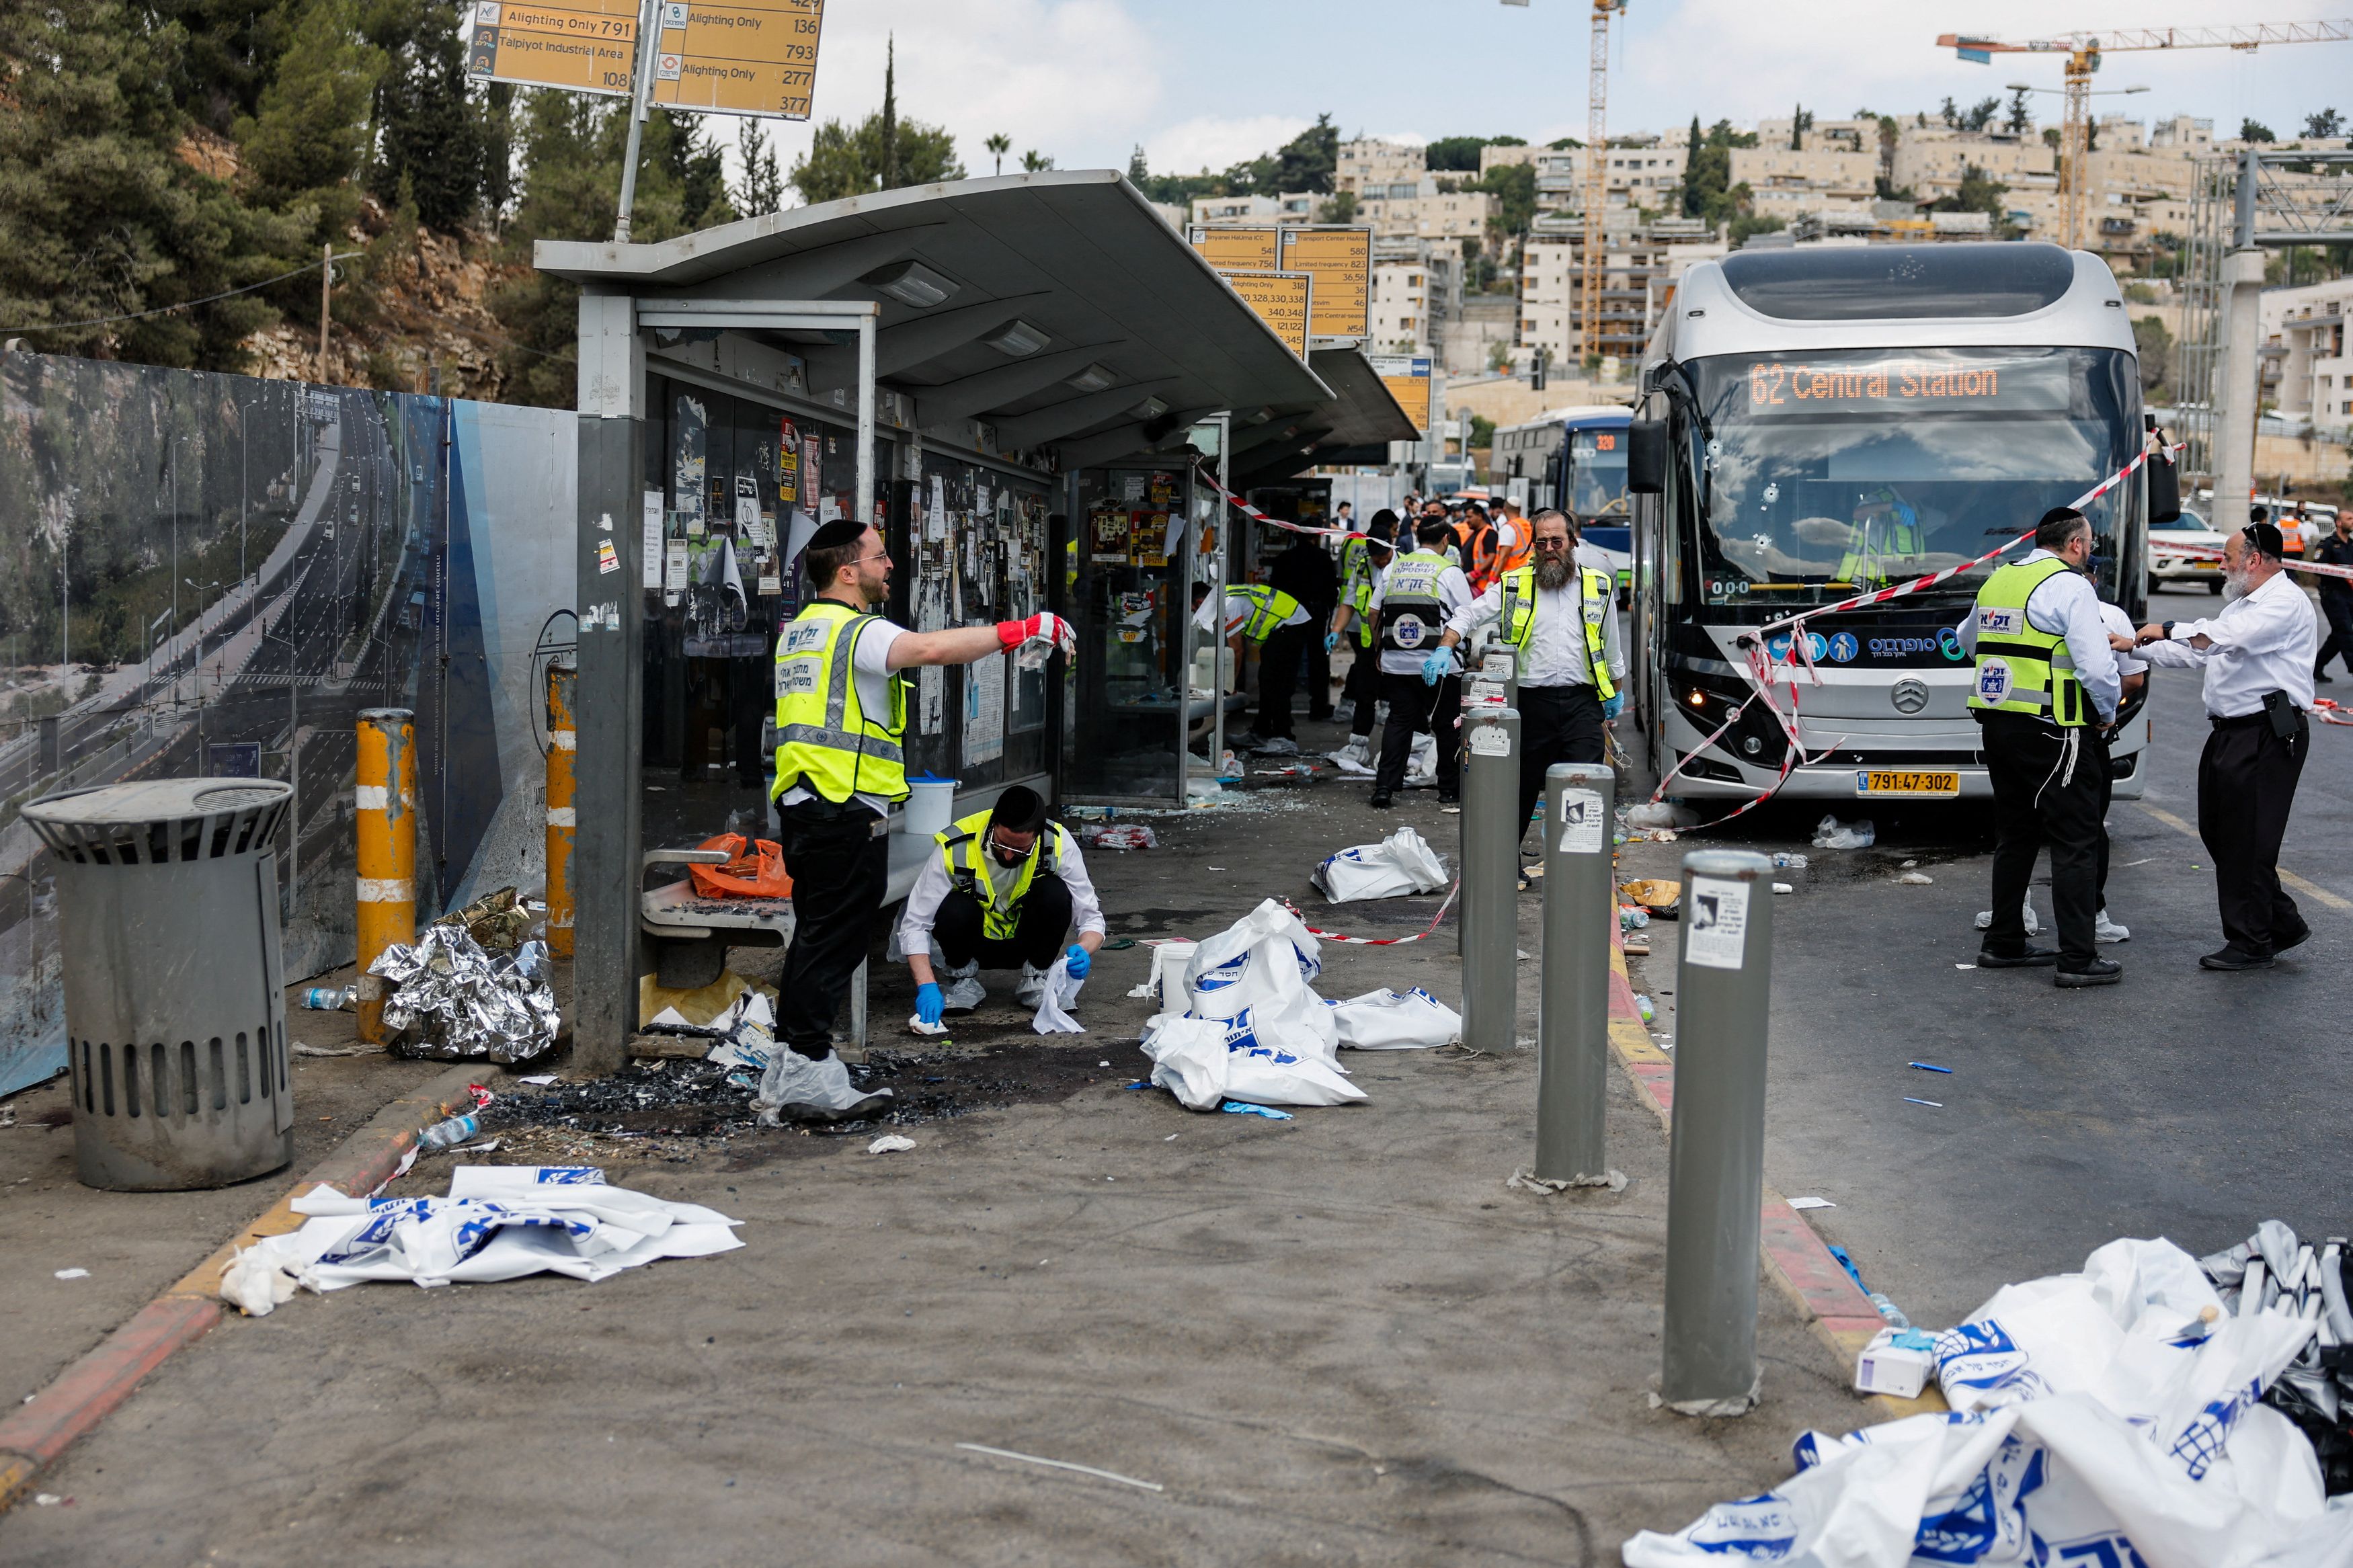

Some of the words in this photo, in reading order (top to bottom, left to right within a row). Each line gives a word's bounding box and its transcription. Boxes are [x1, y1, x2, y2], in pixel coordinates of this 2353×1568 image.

[508, 11, 564, 29] Alighting
[569, 19, 598, 33] Only
[600, 21, 630, 37] 791
[688, 13, 735, 28] Alighting
[737, 17, 762, 30] Only
[795, 19, 817, 34] 136
[500, 36, 543, 51] Talpiyot
[546, 42, 594, 56] Industrial
[598, 46, 623, 59] Area
[786, 44, 813, 60] 793
[603, 72, 627, 87] 108
[682, 65, 727, 79] Alighting
[731, 68, 756, 81] Only
[783, 71, 811, 86] 277
[780, 97, 808, 112] 377
[1227, 259, 1257, 267] frequency
[1343, 274, 1365, 282] 36,56
[1232, 282, 1258, 290] Alighting
[1259, 282, 1273, 290] Only
[1268, 308, 1304, 317] 340,348
[1277, 323, 1303, 332] 121,122
[1751, 364, 1785, 405] 62
[1791, 365, 1888, 399] Central
[1899, 363, 1998, 397] Station
[1868, 638, 1936, 652] סופרבוס
